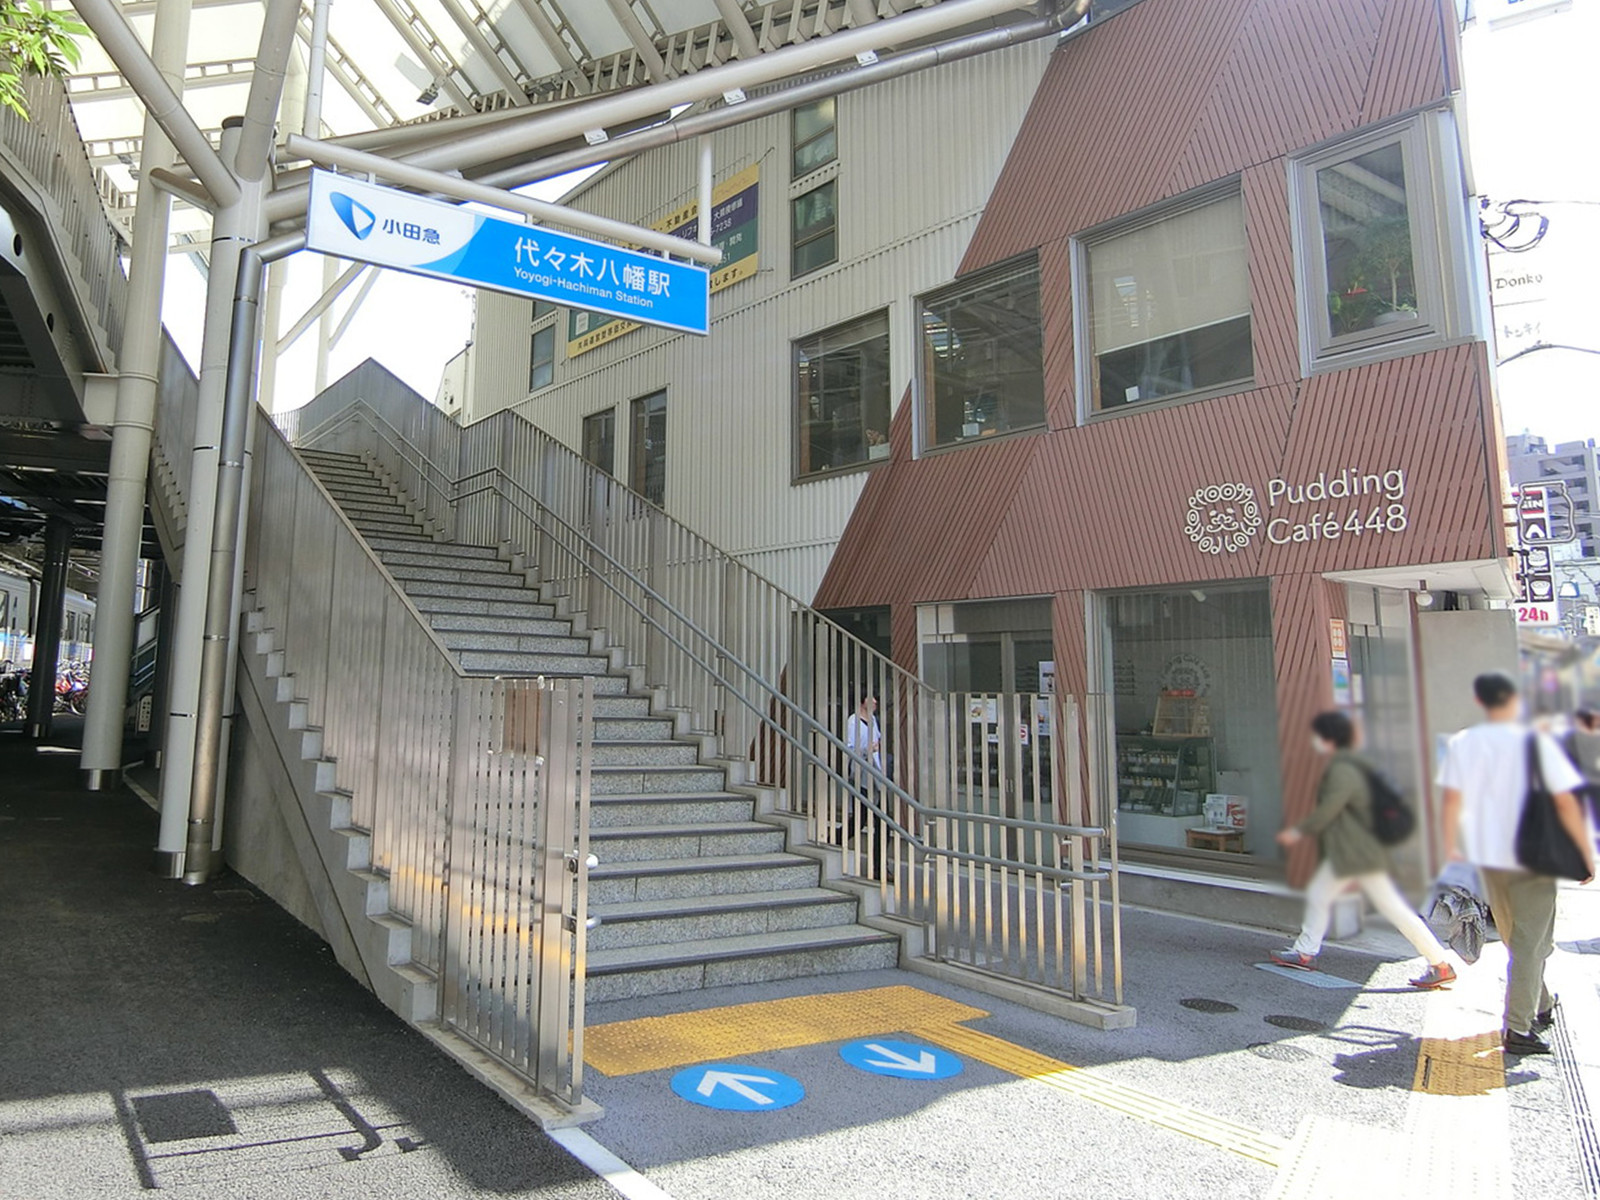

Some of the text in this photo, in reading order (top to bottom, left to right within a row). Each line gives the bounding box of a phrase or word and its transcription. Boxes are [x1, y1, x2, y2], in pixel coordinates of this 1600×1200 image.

[382, 217, 441, 246] 小田急
[513, 267, 654, 308] Yoyogi-Hachiman Station
[514, 237, 671, 299] 代々木八幡駅
[1268, 467, 1405, 507] Pudding
